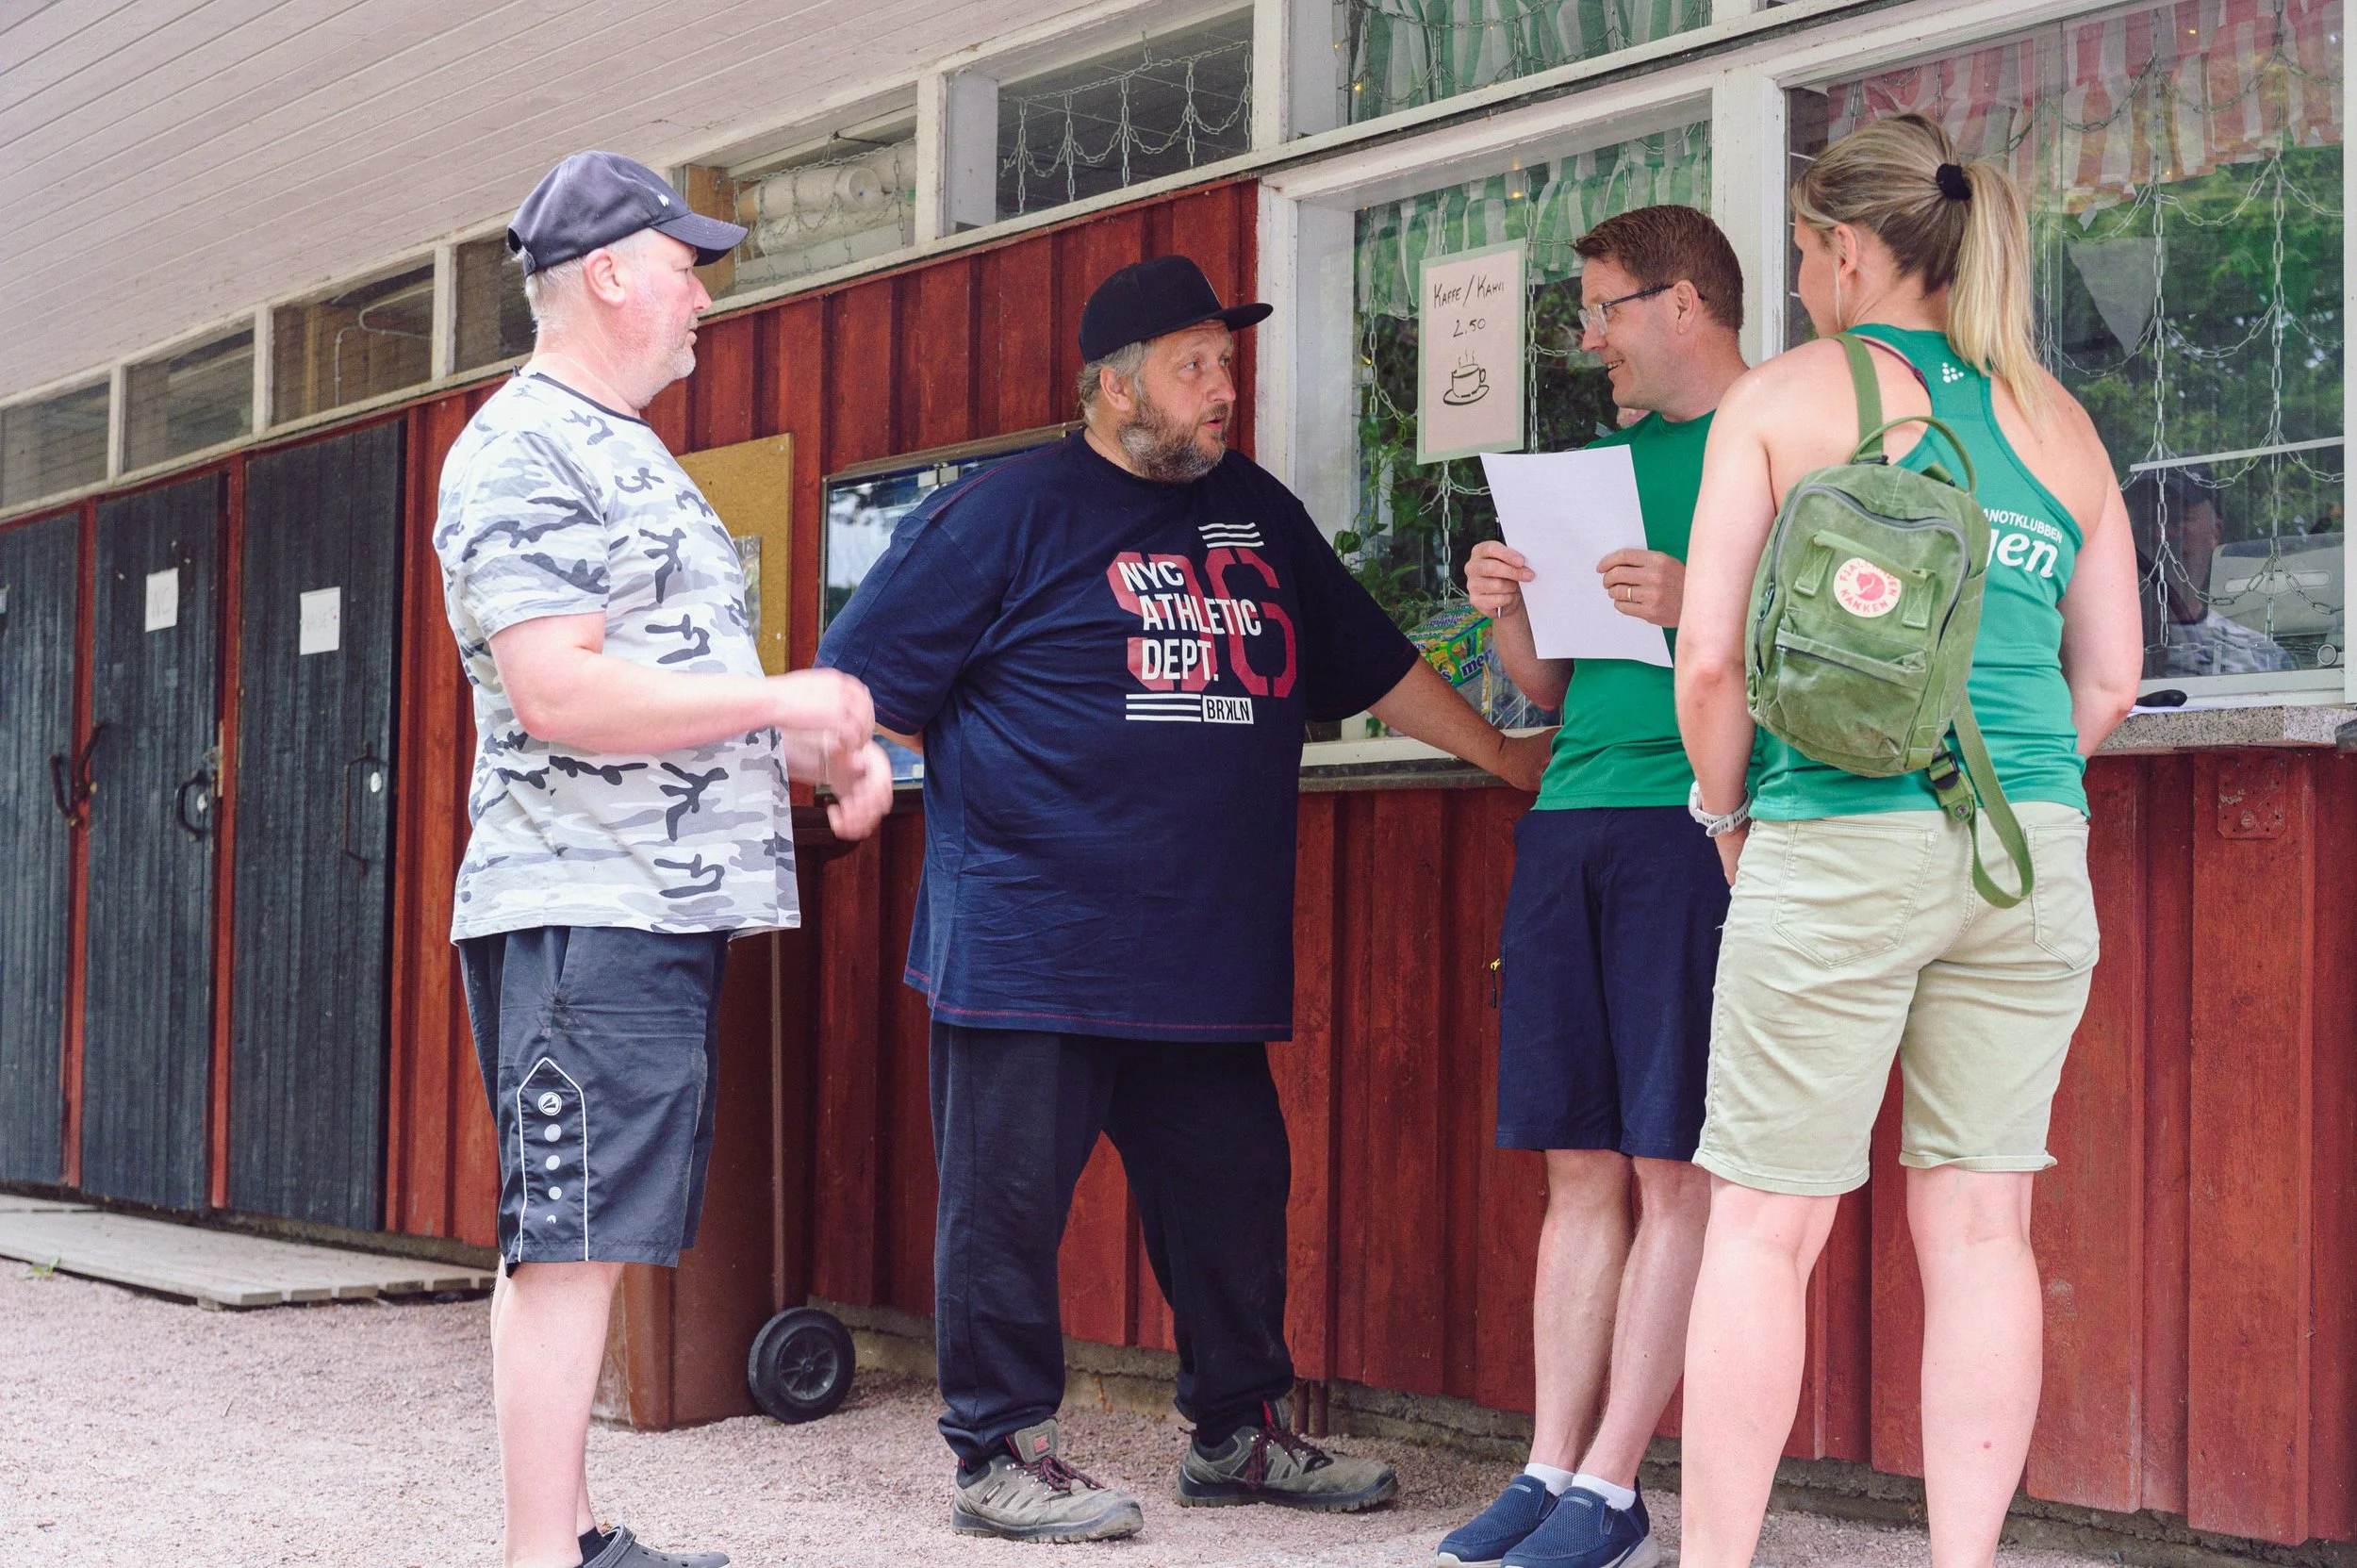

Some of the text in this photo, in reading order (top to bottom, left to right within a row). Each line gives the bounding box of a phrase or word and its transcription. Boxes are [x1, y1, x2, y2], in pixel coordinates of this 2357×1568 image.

[1453, 318, 1487, 338] 2.50
[1117, 561, 1185, 592] NYC
[1138, 593, 1262, 636] ATHLETIC
[1141, 638, 1220, 682] DEPT.
